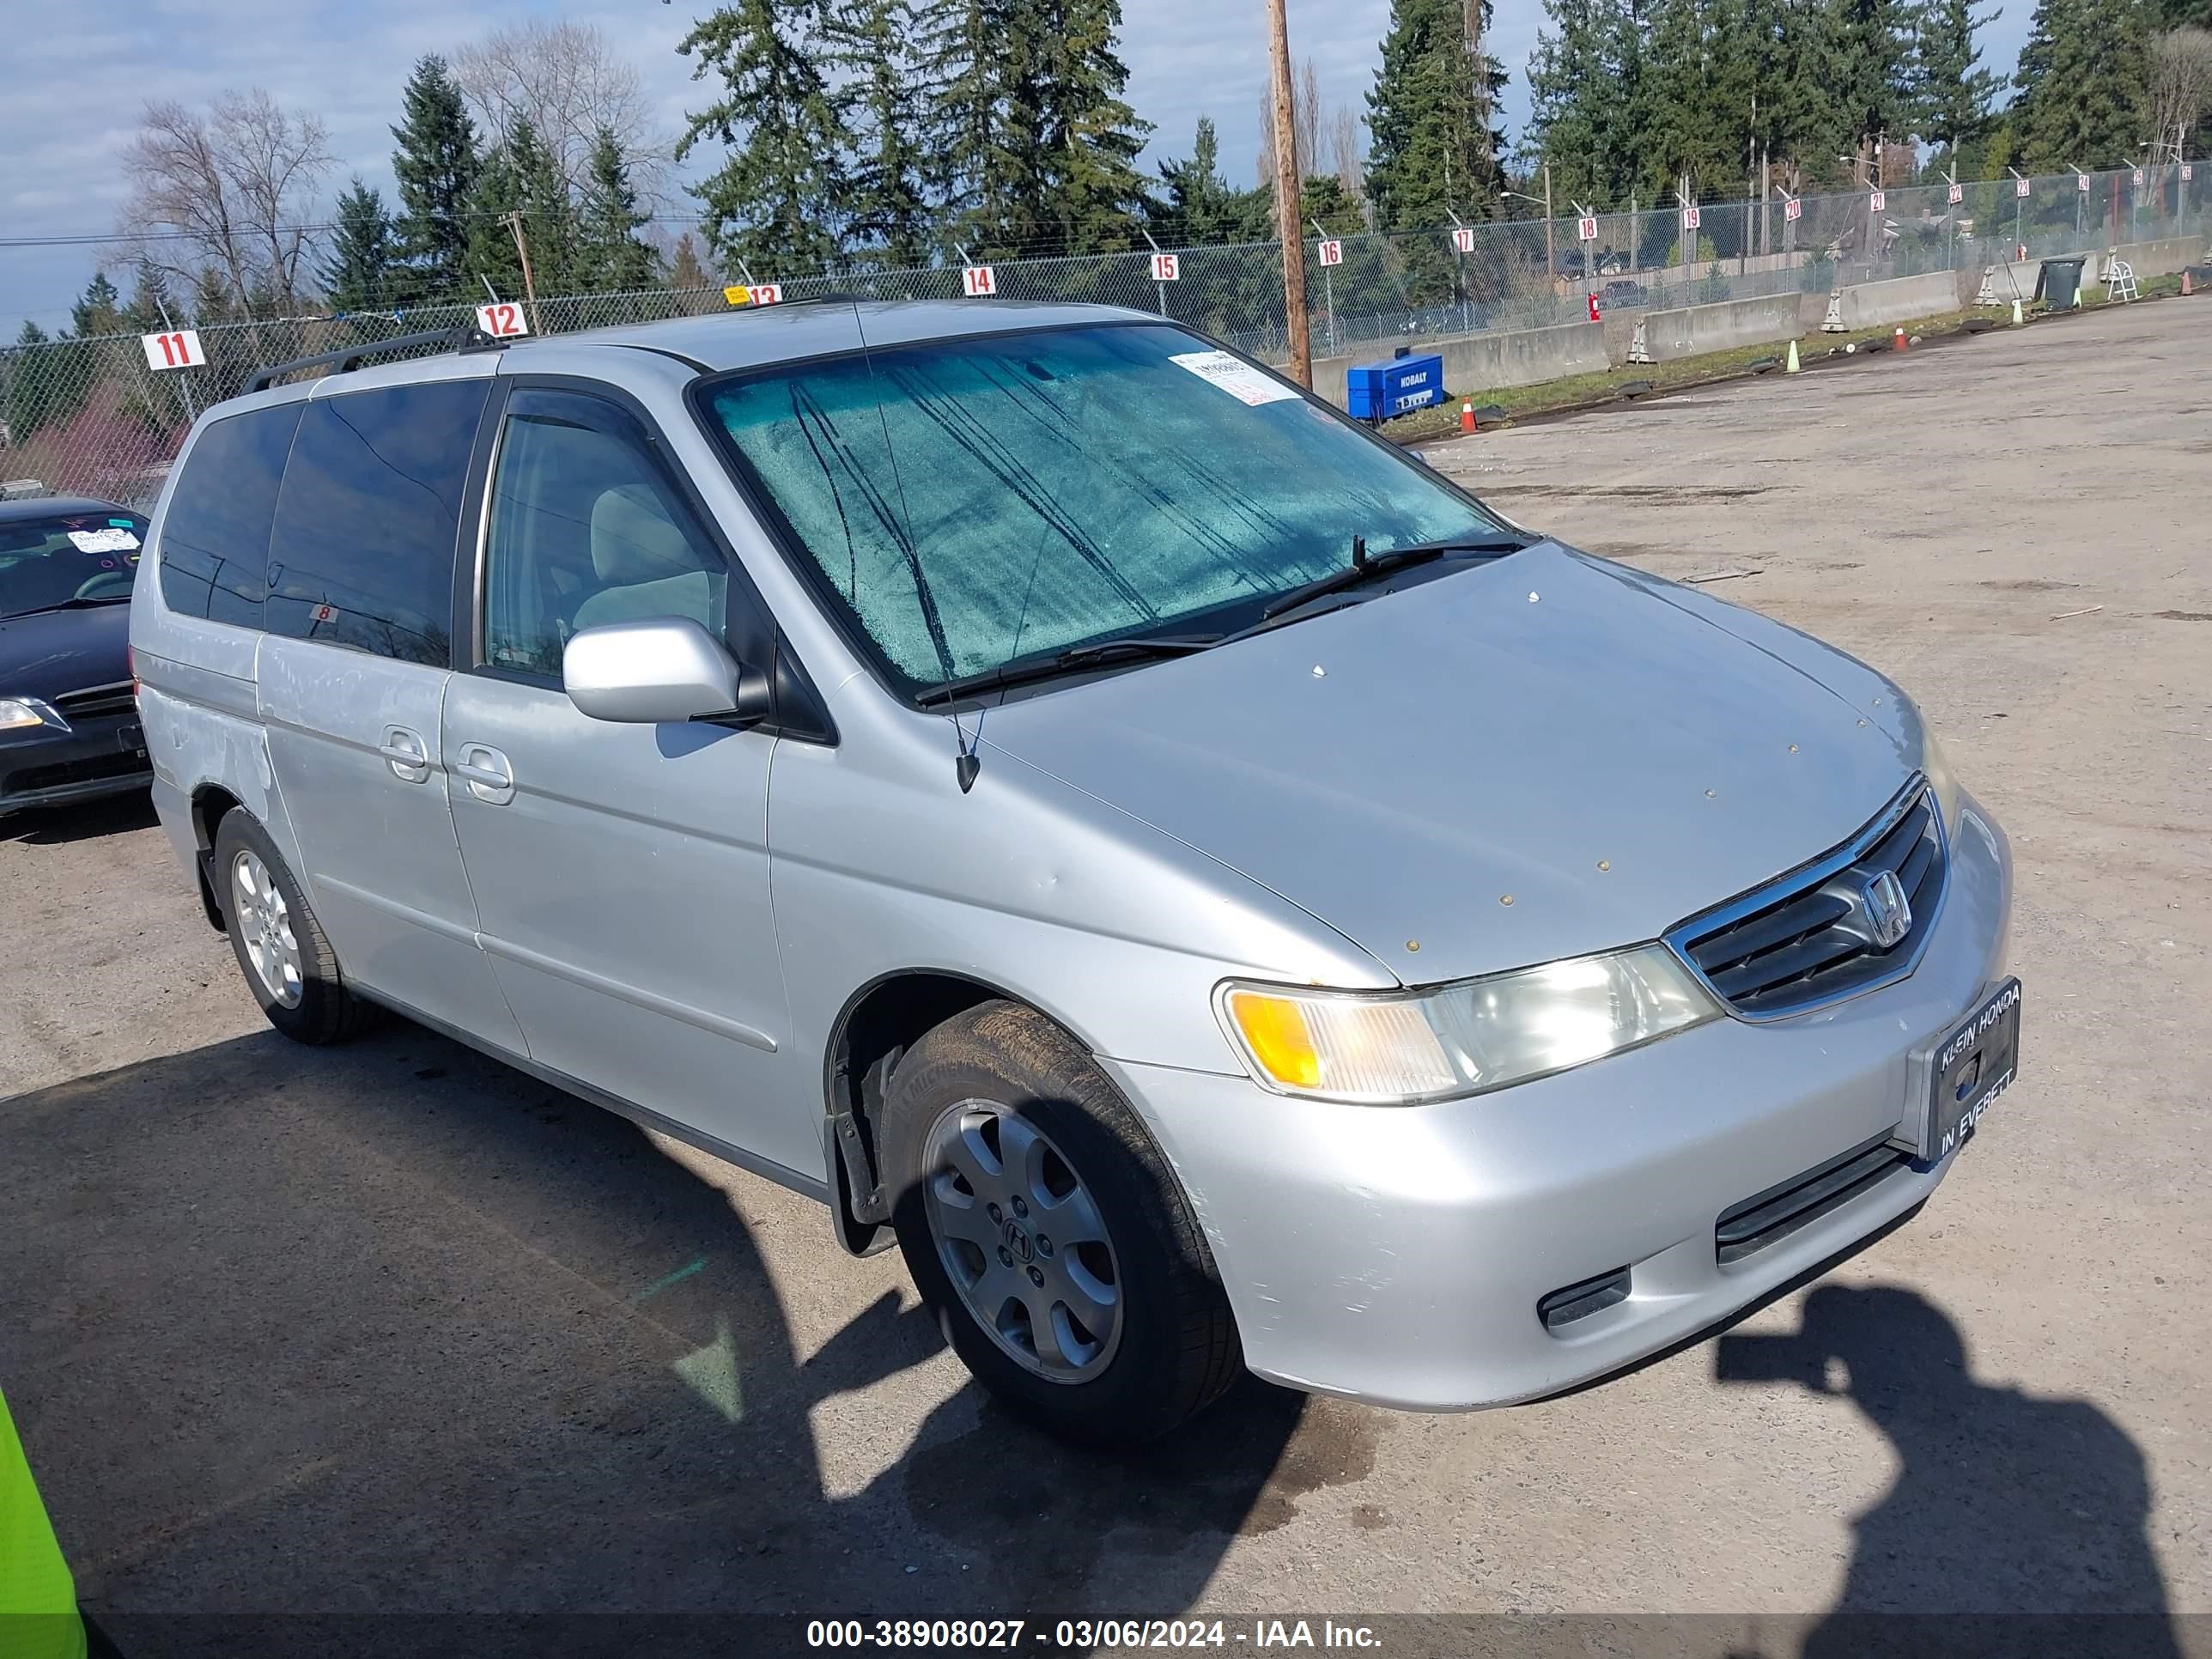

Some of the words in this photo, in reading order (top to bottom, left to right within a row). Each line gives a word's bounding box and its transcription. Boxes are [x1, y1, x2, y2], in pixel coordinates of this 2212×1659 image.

[2134, 169, 2142, 184] 25
[2183, 166, 2191, 179] 26
[2018, 180, 2029, 196] 23
[2079, 175, 2089, 190] 24
[1872, 192, 1884, 211] 21
[1950, 185, 1962, 203] 22
[1686, 209, 1698, 227] 19
[1786, 201, 1801, 220] 20
[1581, 219, 1595, 239] 18
[1456, 230, 1470, 250] 17
[1322, 241, 1340, 264] 16
[1156, 255, 1175, 279] 15
[969, 269, 990, 291] 14
[750, 287, 775, 305] 13
[486, 306, 518, 335] 12
[158, 333, 191, 366] 11
[1401, 372, 1427, 389] KOBALT
[1942, 1023, 1977, 1072] KLEIN
[1979, 985, 2021, 1035] HONDA
[1942, 1127, 1955, 1156] IN
[1960, 1068, 2013, 1137] EVERETT
